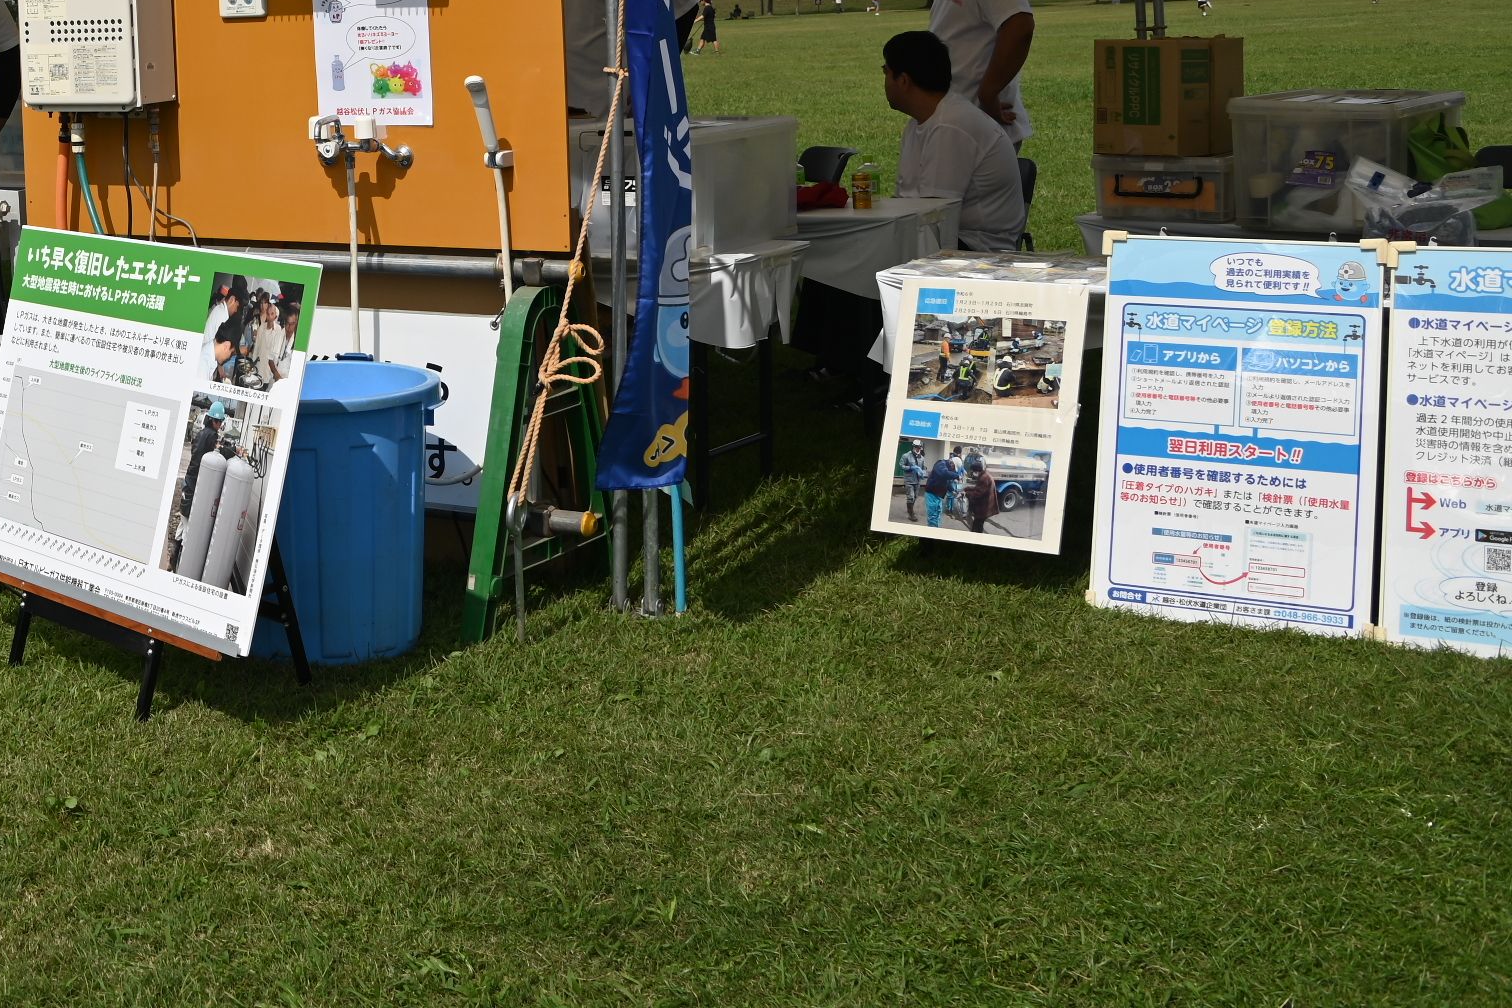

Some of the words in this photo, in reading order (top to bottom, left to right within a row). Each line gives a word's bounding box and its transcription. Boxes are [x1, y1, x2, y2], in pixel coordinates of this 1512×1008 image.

[1314, 155, 1335, 171] 75
[27, 245, 201, 290] いち早く復旧したエネルギー
[1226, 257, 1264, 267] いつでも
[1226, 268, 1310, 280] 過去のご利用実績を
[22, 273, 166, 311] 大型地震発生時におけるLPガスの活躍
[1145, 311, 1264, 335] 水道マイページ
[1267, 319, 1338, 340] 登録方法
[1417, 336, 1512, 350] 上下水道の利用が
[1162, 349, 1221, 364] アプリから
[1276, 356, 1350, 372] パソコンから
[48, 359, 143, 388] 大型地震発生後のライフライン復旧状況
[1406, 373, 1477, 387] サービスです。
[1133, 463, 1308, 490] 使用者番号を確認するためには
[1404, 472, 1498, 489] 登録はこちらから
[1439, 497, 1467, 510] Web
[1485, 504, 1512, 513] 水道マ
[1439, 527, 1471, 539] アプリ
[1489, 534, 1507, 543] Google
[1475, 581, 1498, 592] 登録
[1111, 589, 1143, 601] お問合せ
[1236, 605, 1271, 616] お客さま課
[1281, 609, 1345, 625] 048-966-3933
[1409, 622, 1498, 639] ませんのでご留意ください。
